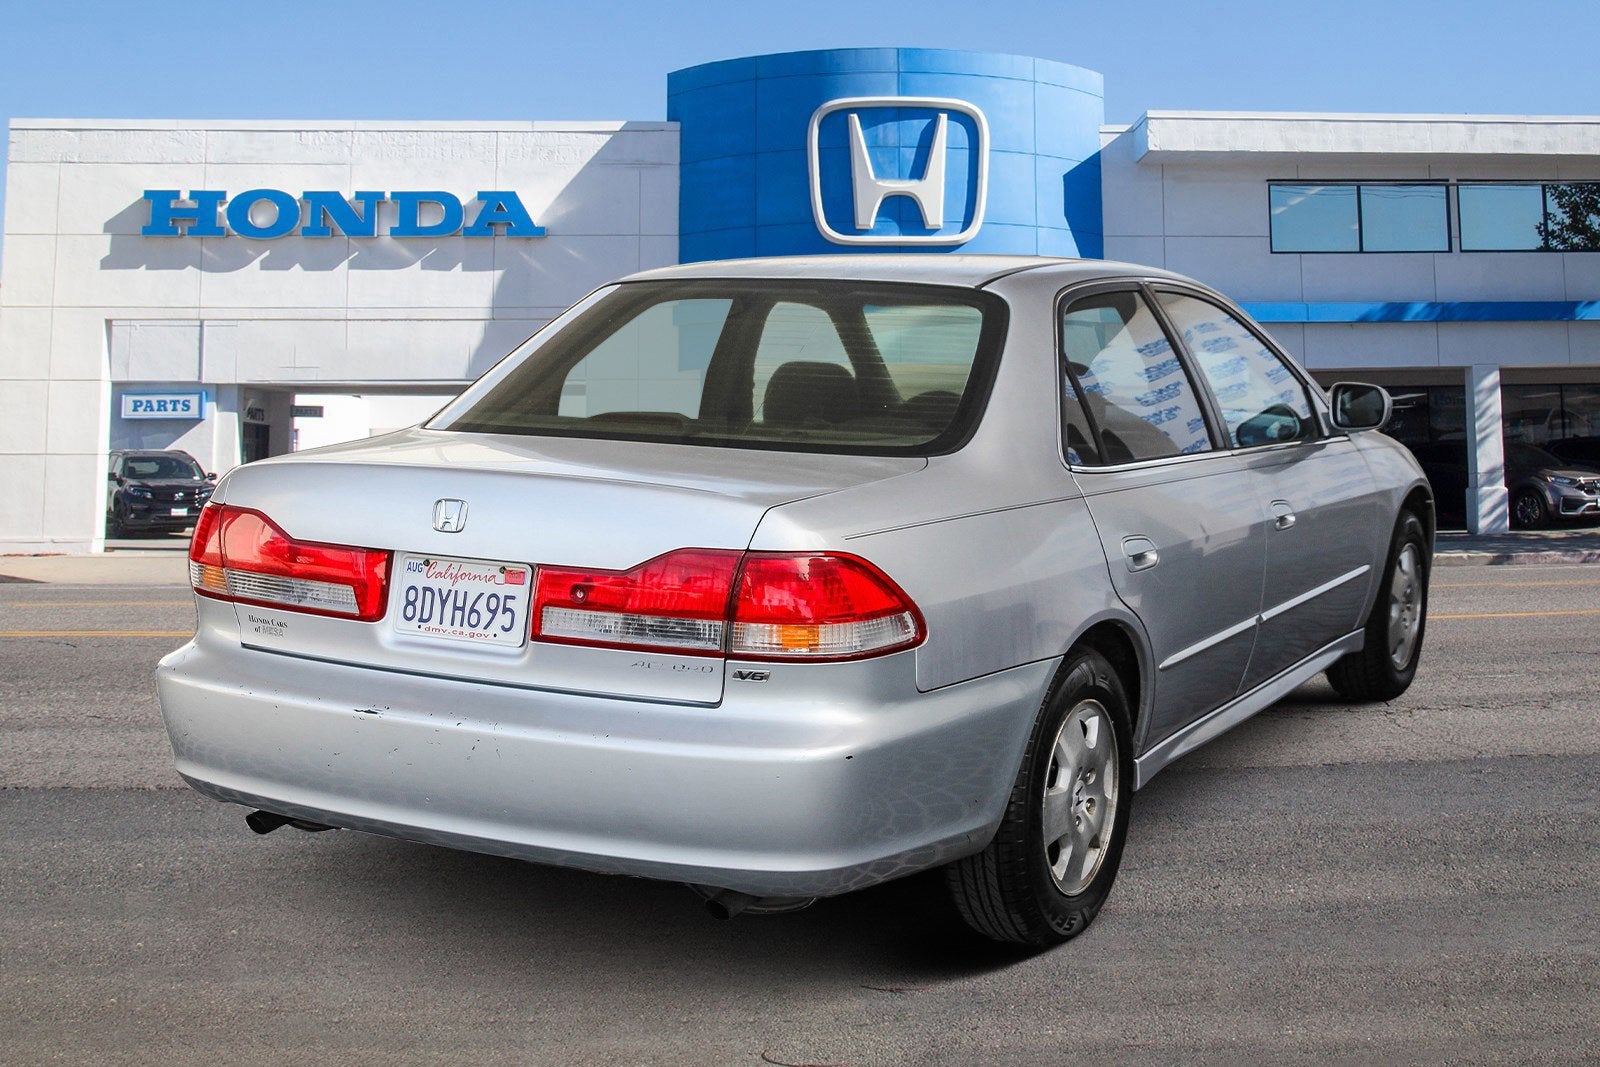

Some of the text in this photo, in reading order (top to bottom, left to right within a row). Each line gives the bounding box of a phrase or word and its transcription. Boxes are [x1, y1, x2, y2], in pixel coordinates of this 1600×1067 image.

[141, 188, 547, 240] HONDA
[132, 399, 191, 412] PARTS
[406, 561, 424, 573] AUG
[425, 560, 505, 587] California
[402, 585, 517, 633] 8DYH695
[424, 625, 491, 639] dmv.ca.gov
[736, 670, 765, 681] V6
